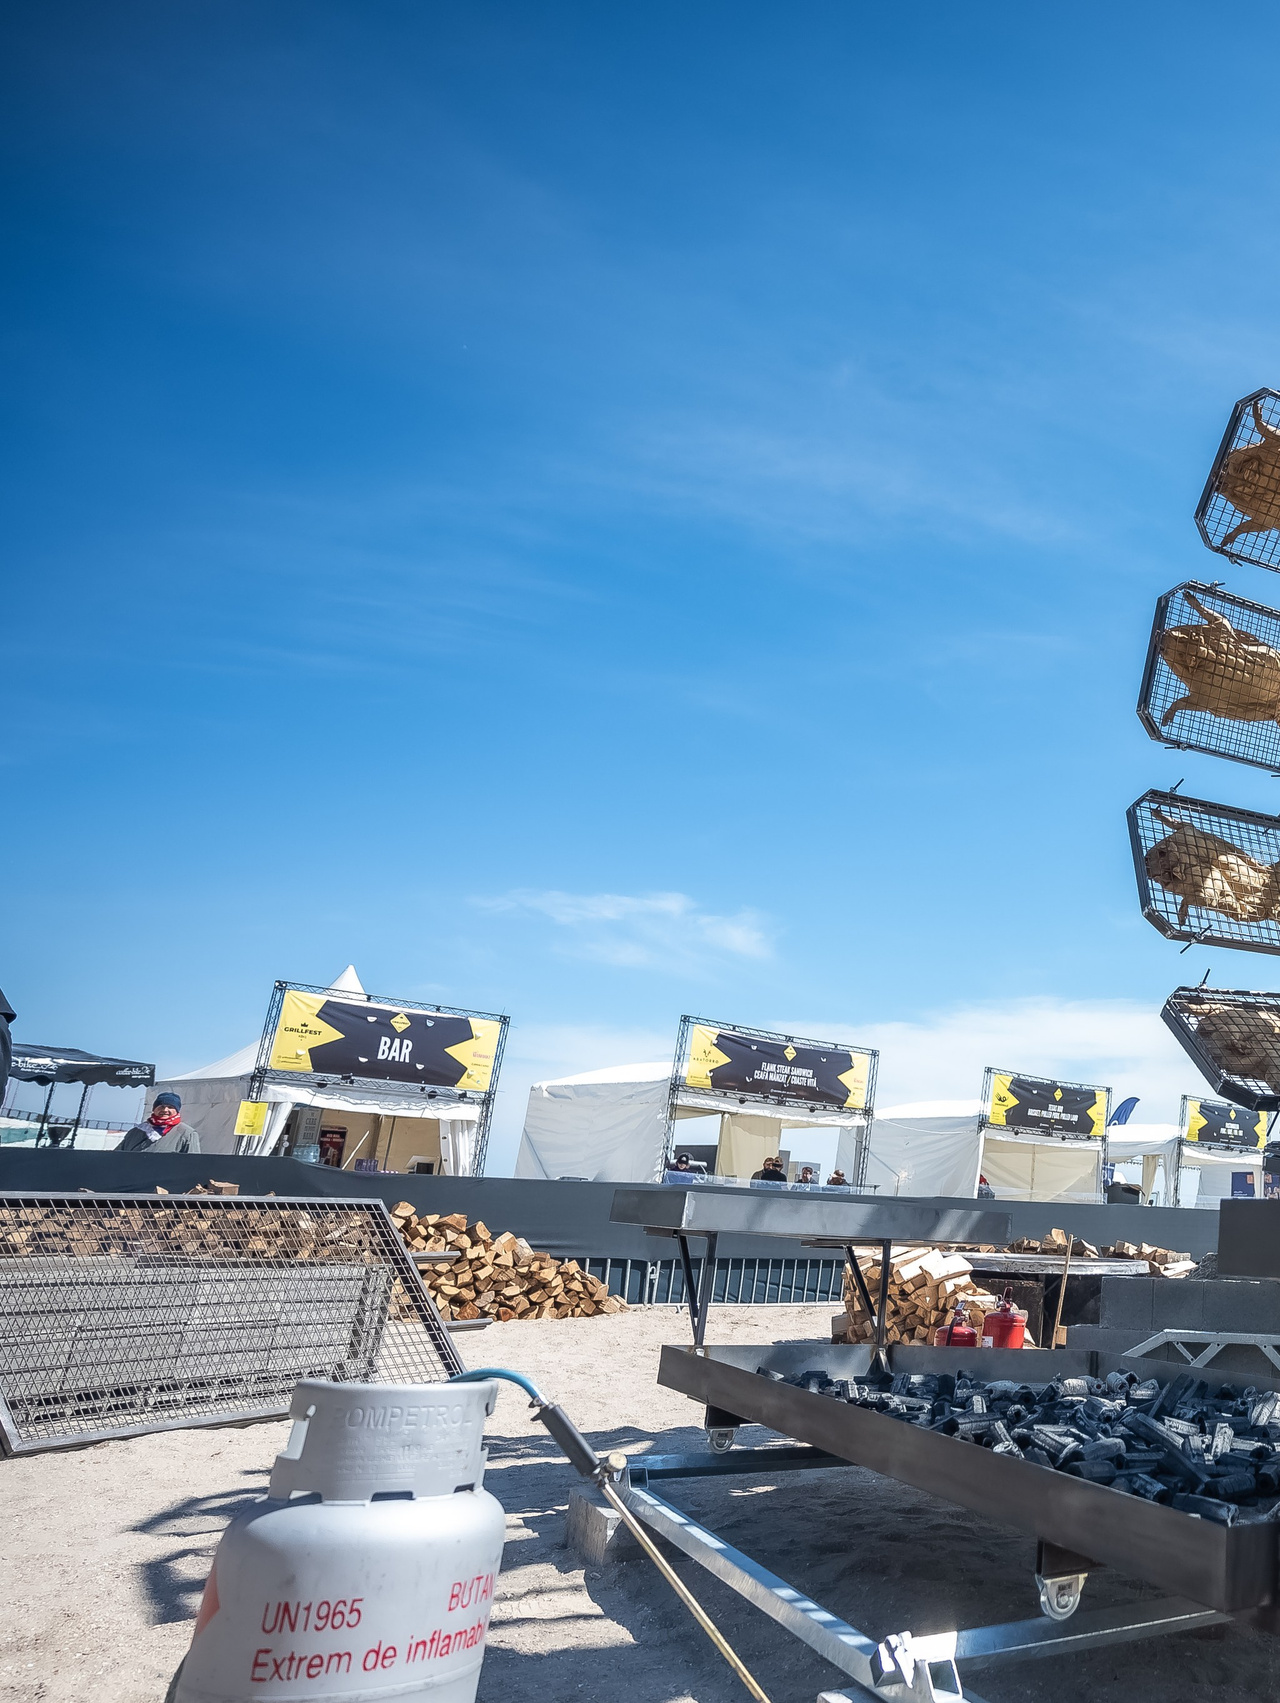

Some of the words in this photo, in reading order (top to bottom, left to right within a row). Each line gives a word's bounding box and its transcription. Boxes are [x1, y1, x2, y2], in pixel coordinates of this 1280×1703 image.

[284, 1026, 322, 1036] GRILLFEST
[377, 1036, 413, 1063] BAR
[335, 1404, 473, 1430] OMPETROL
[261, 1597, 364, 1634] UN1965
[250, 1648, 351, 1682] Extrem
[362, 1640, 397, 1672] de
